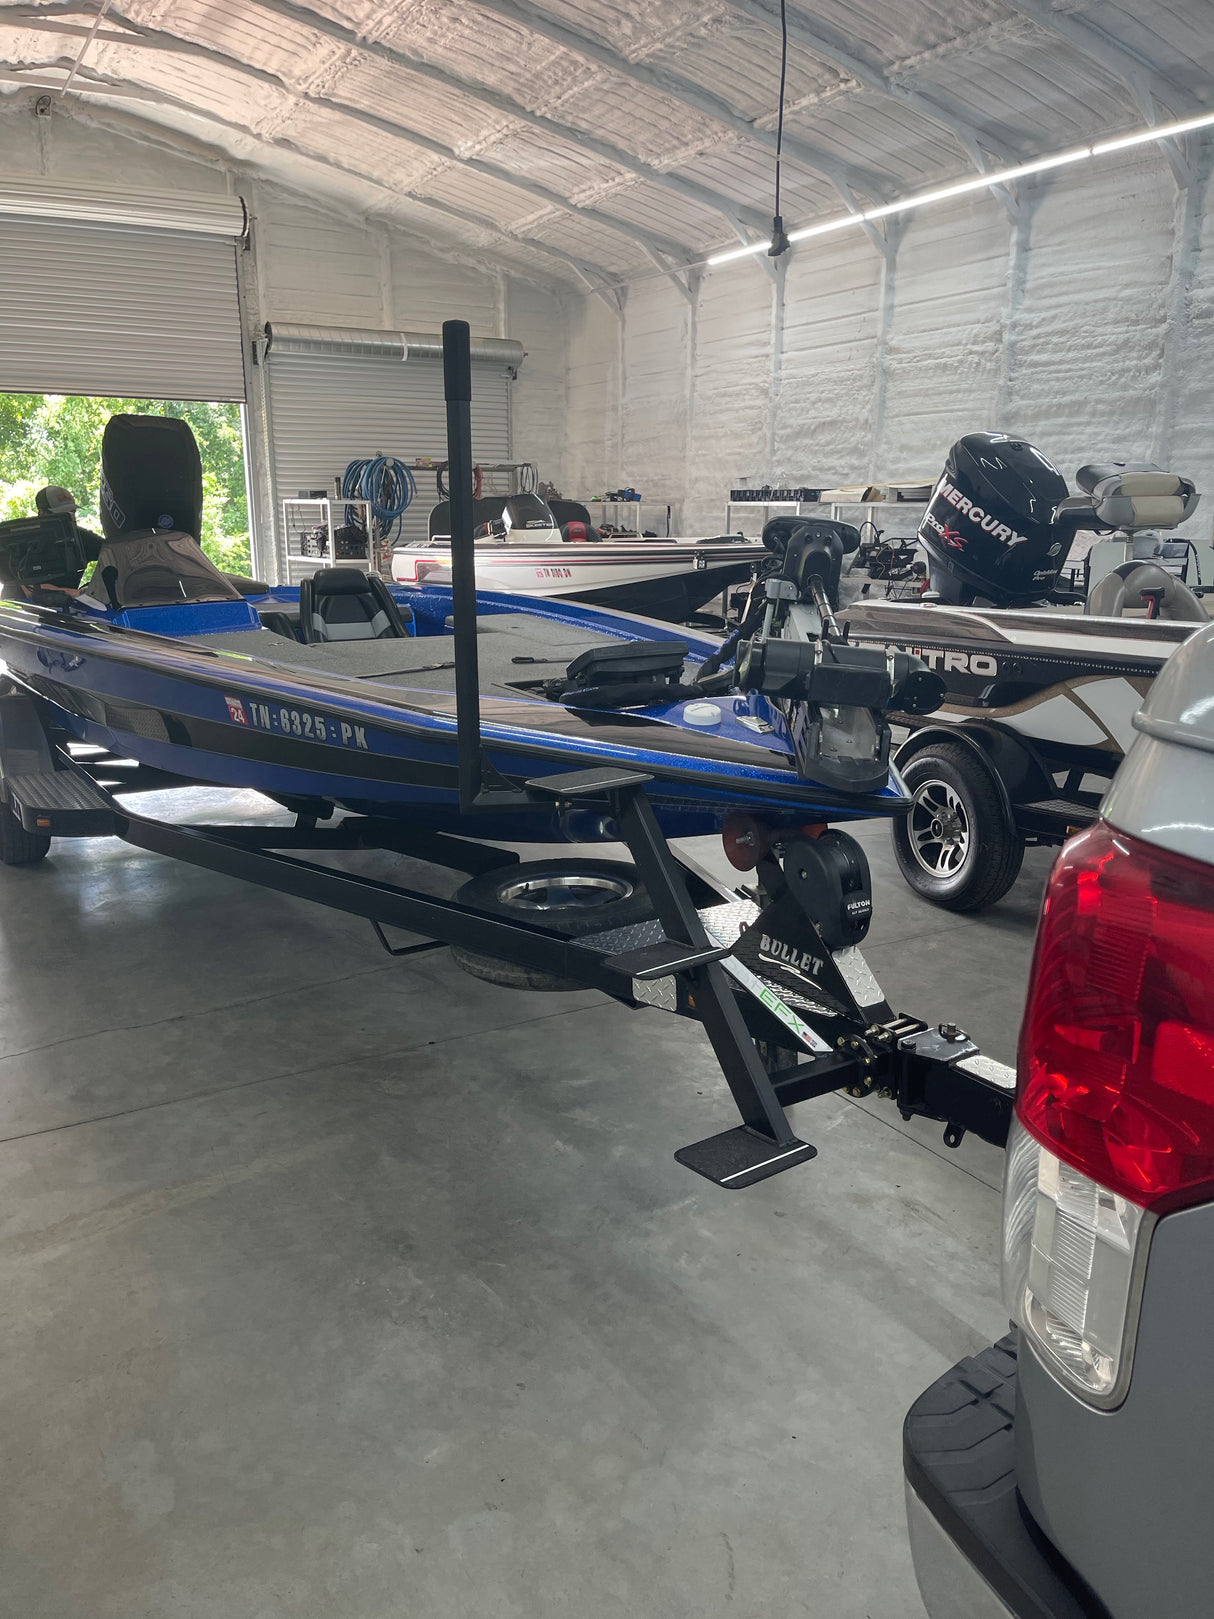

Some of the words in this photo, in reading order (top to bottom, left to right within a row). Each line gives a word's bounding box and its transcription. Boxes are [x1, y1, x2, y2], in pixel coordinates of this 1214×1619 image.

[939, 480, 1028, 547] MERCURY
[887, 644, 998, 677] ITRO
[230, 706, 245, 724] 24
[847, 899, 871, 910] FULTON
[759, 933, 824, 976] BULLET
